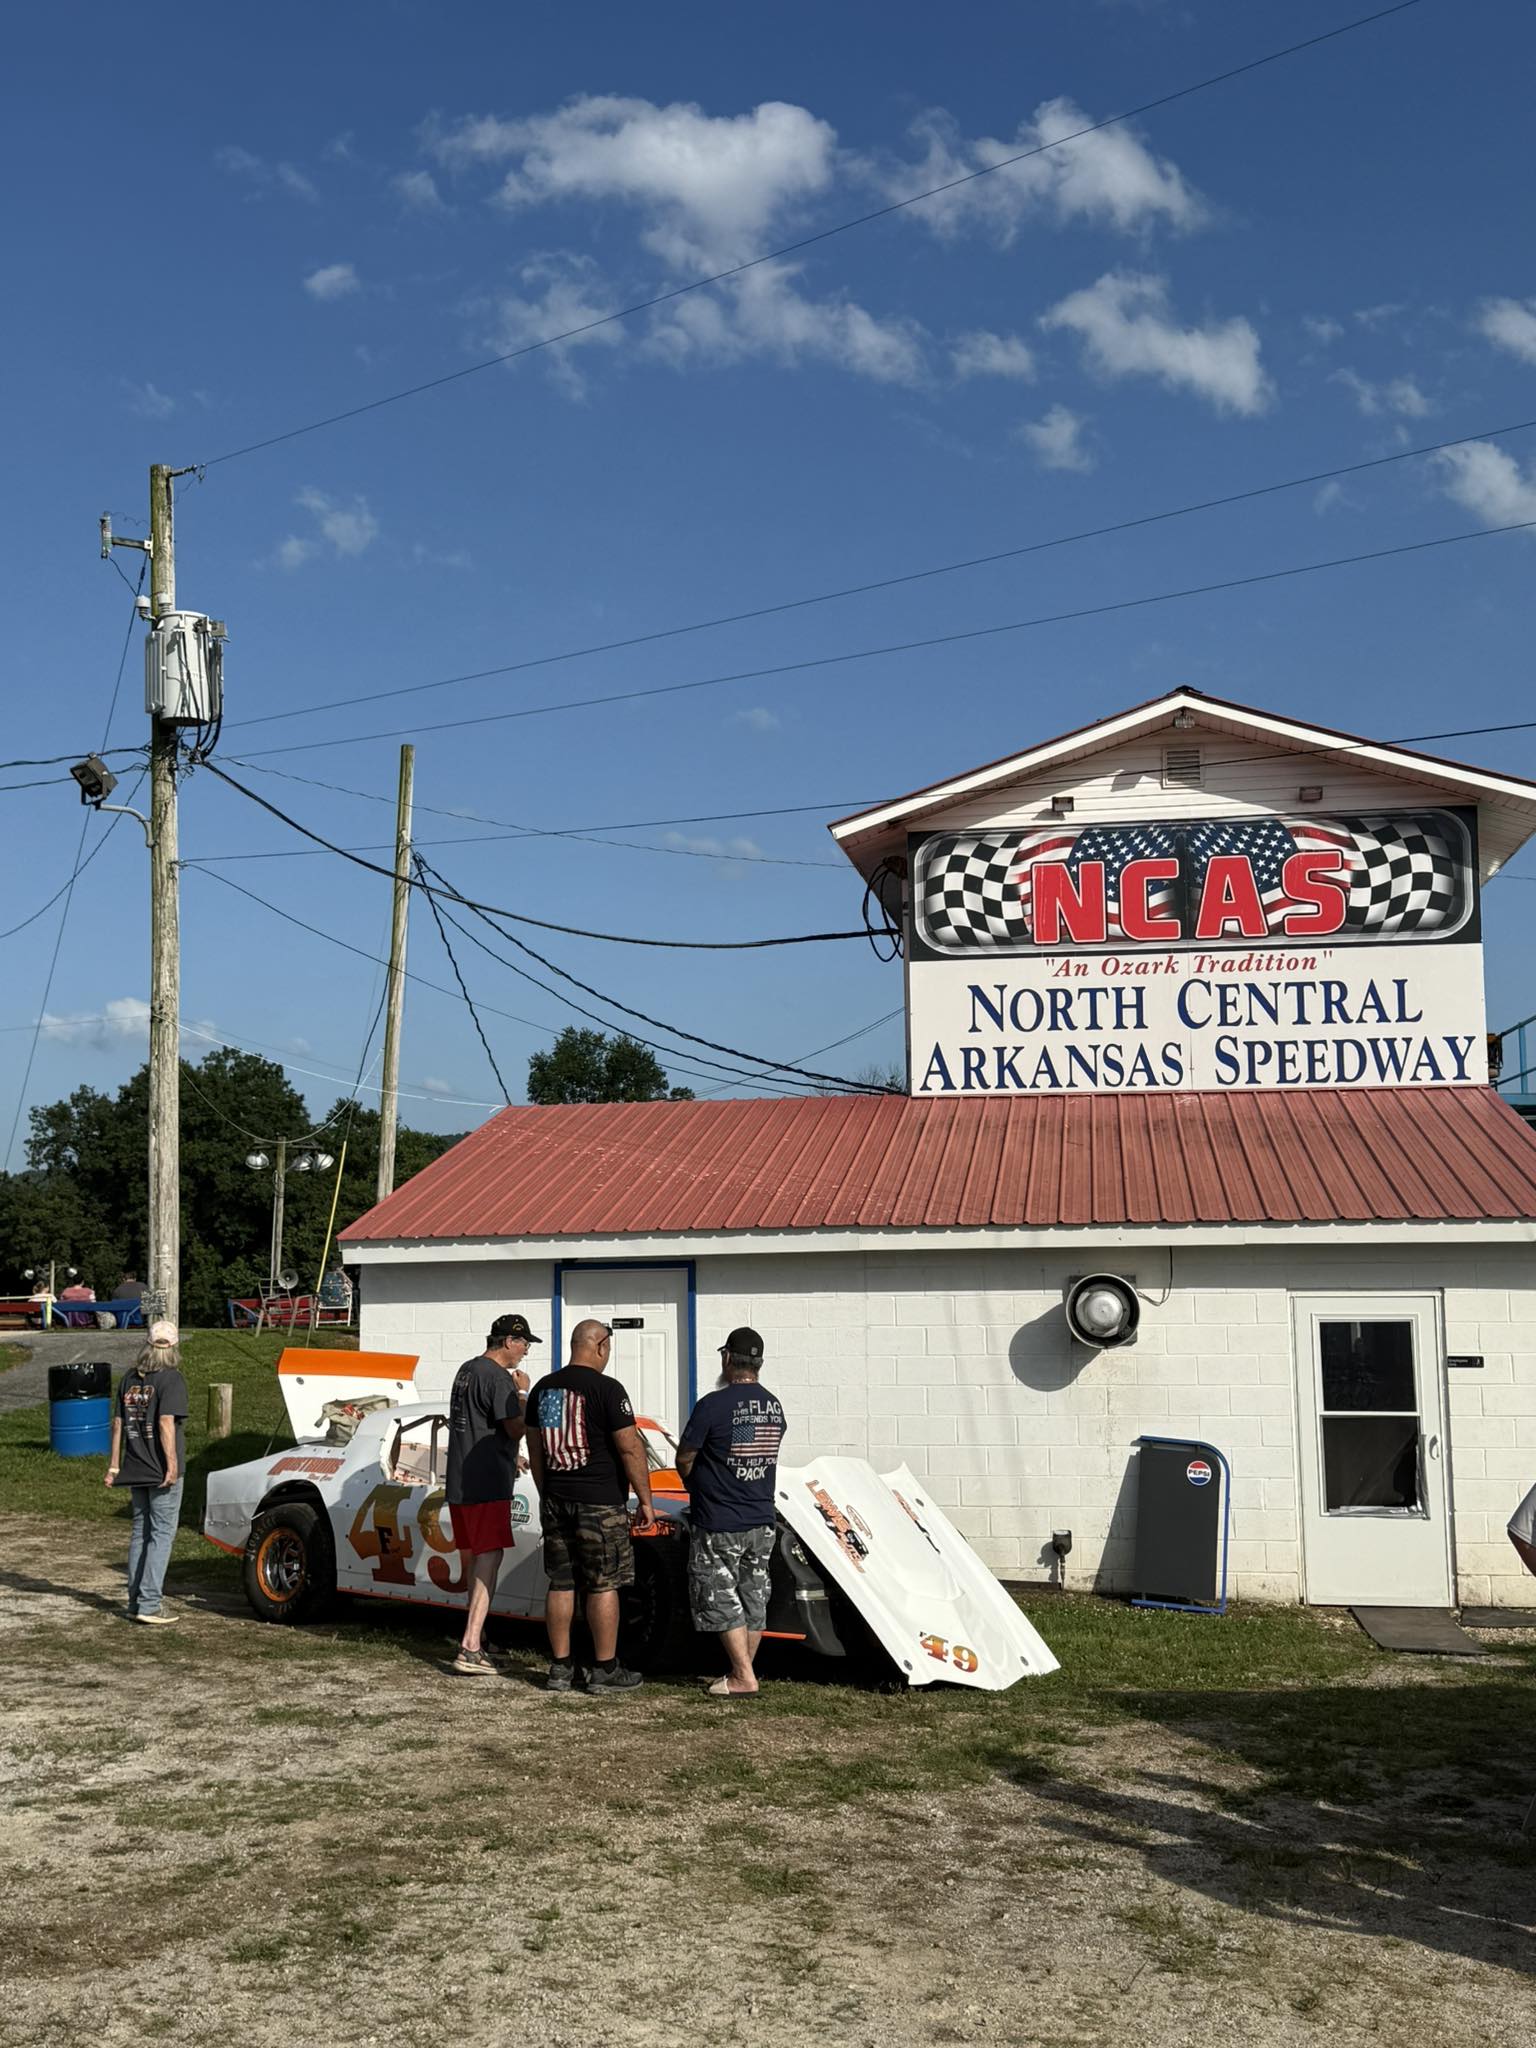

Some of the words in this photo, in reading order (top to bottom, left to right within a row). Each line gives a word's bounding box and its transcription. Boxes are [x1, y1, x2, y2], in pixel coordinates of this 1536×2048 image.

[1031, 850, 1348, 945] NCAS
[1046, 957, 1090, 977] "An
[1101, 955, 1179, 976] Ozark
[1193, 950, 1334, 974] Tradition"
[967, 984, 1148, 1033] NORTH
[1177, 978, 1423, 1030] CENTRAL
[919, 1041, 1184, 1091] ARKANSAS
[1214, 1034, 1477, 1086] SPEEDWAY
[732, 1408, 749, 1416] THIS
[749, 1400, 782, 1415] FLAG
[732, 1416, 769, 1426] OFFENDS
[770, 1415, 783, 1424] YOU
[735, 1465, 769, 1482] PACK
[745, 1457, 764, 1467] HELP
[1188, 1468, 1210, 1477] PEPSI
[347, 1484, 470, 1594] 49
[919, 1634, 979, 1673] 49
